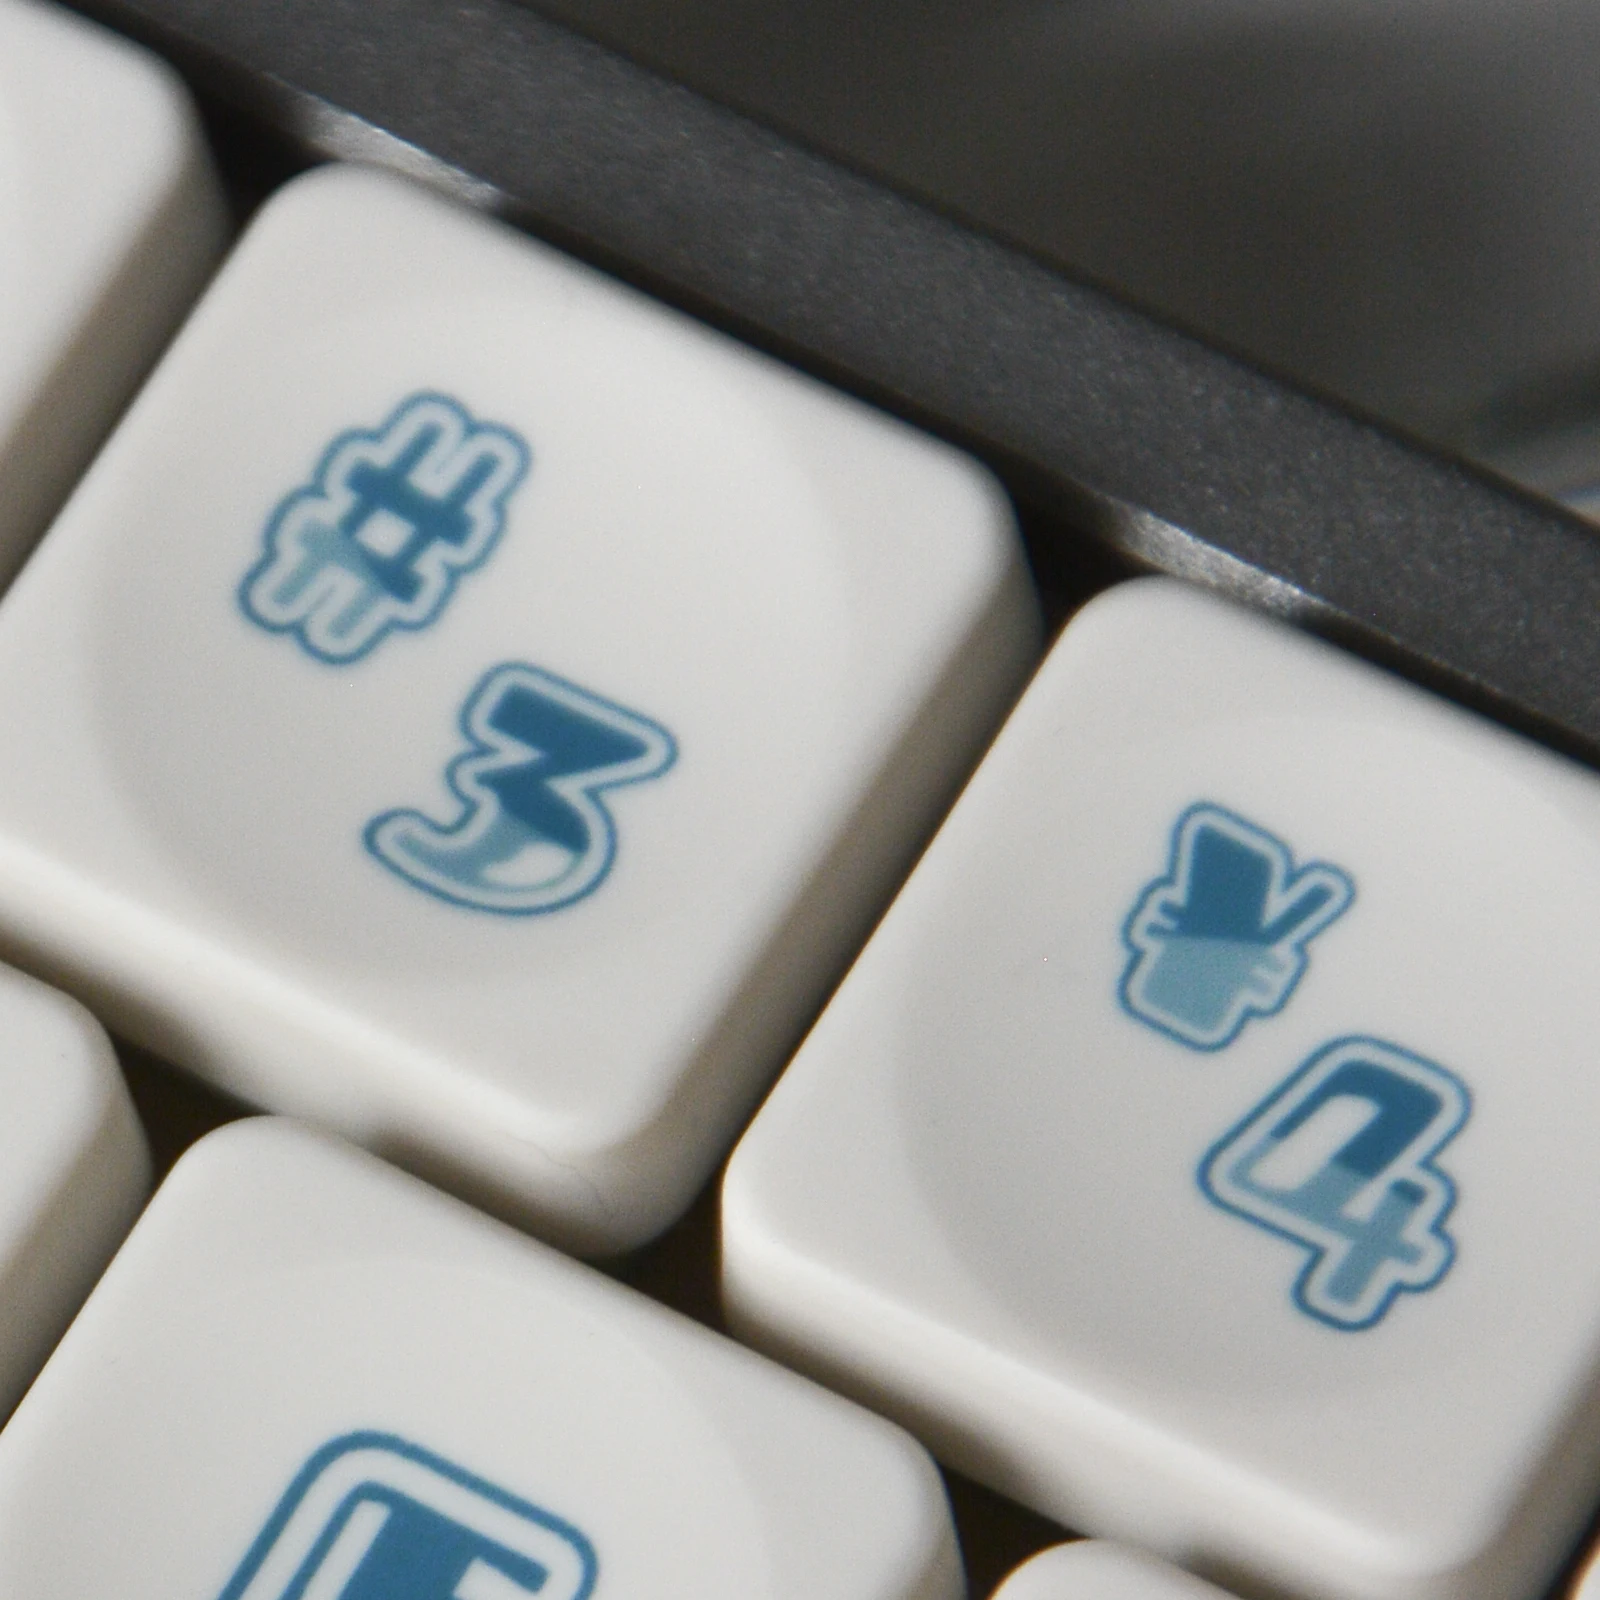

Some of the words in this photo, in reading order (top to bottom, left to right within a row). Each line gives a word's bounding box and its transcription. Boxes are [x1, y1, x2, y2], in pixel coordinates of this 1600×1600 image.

[238, 391, 531, 667] #
[362, 661, 679, 917] 3
[1195, 1034, 1472, 1334] 4
